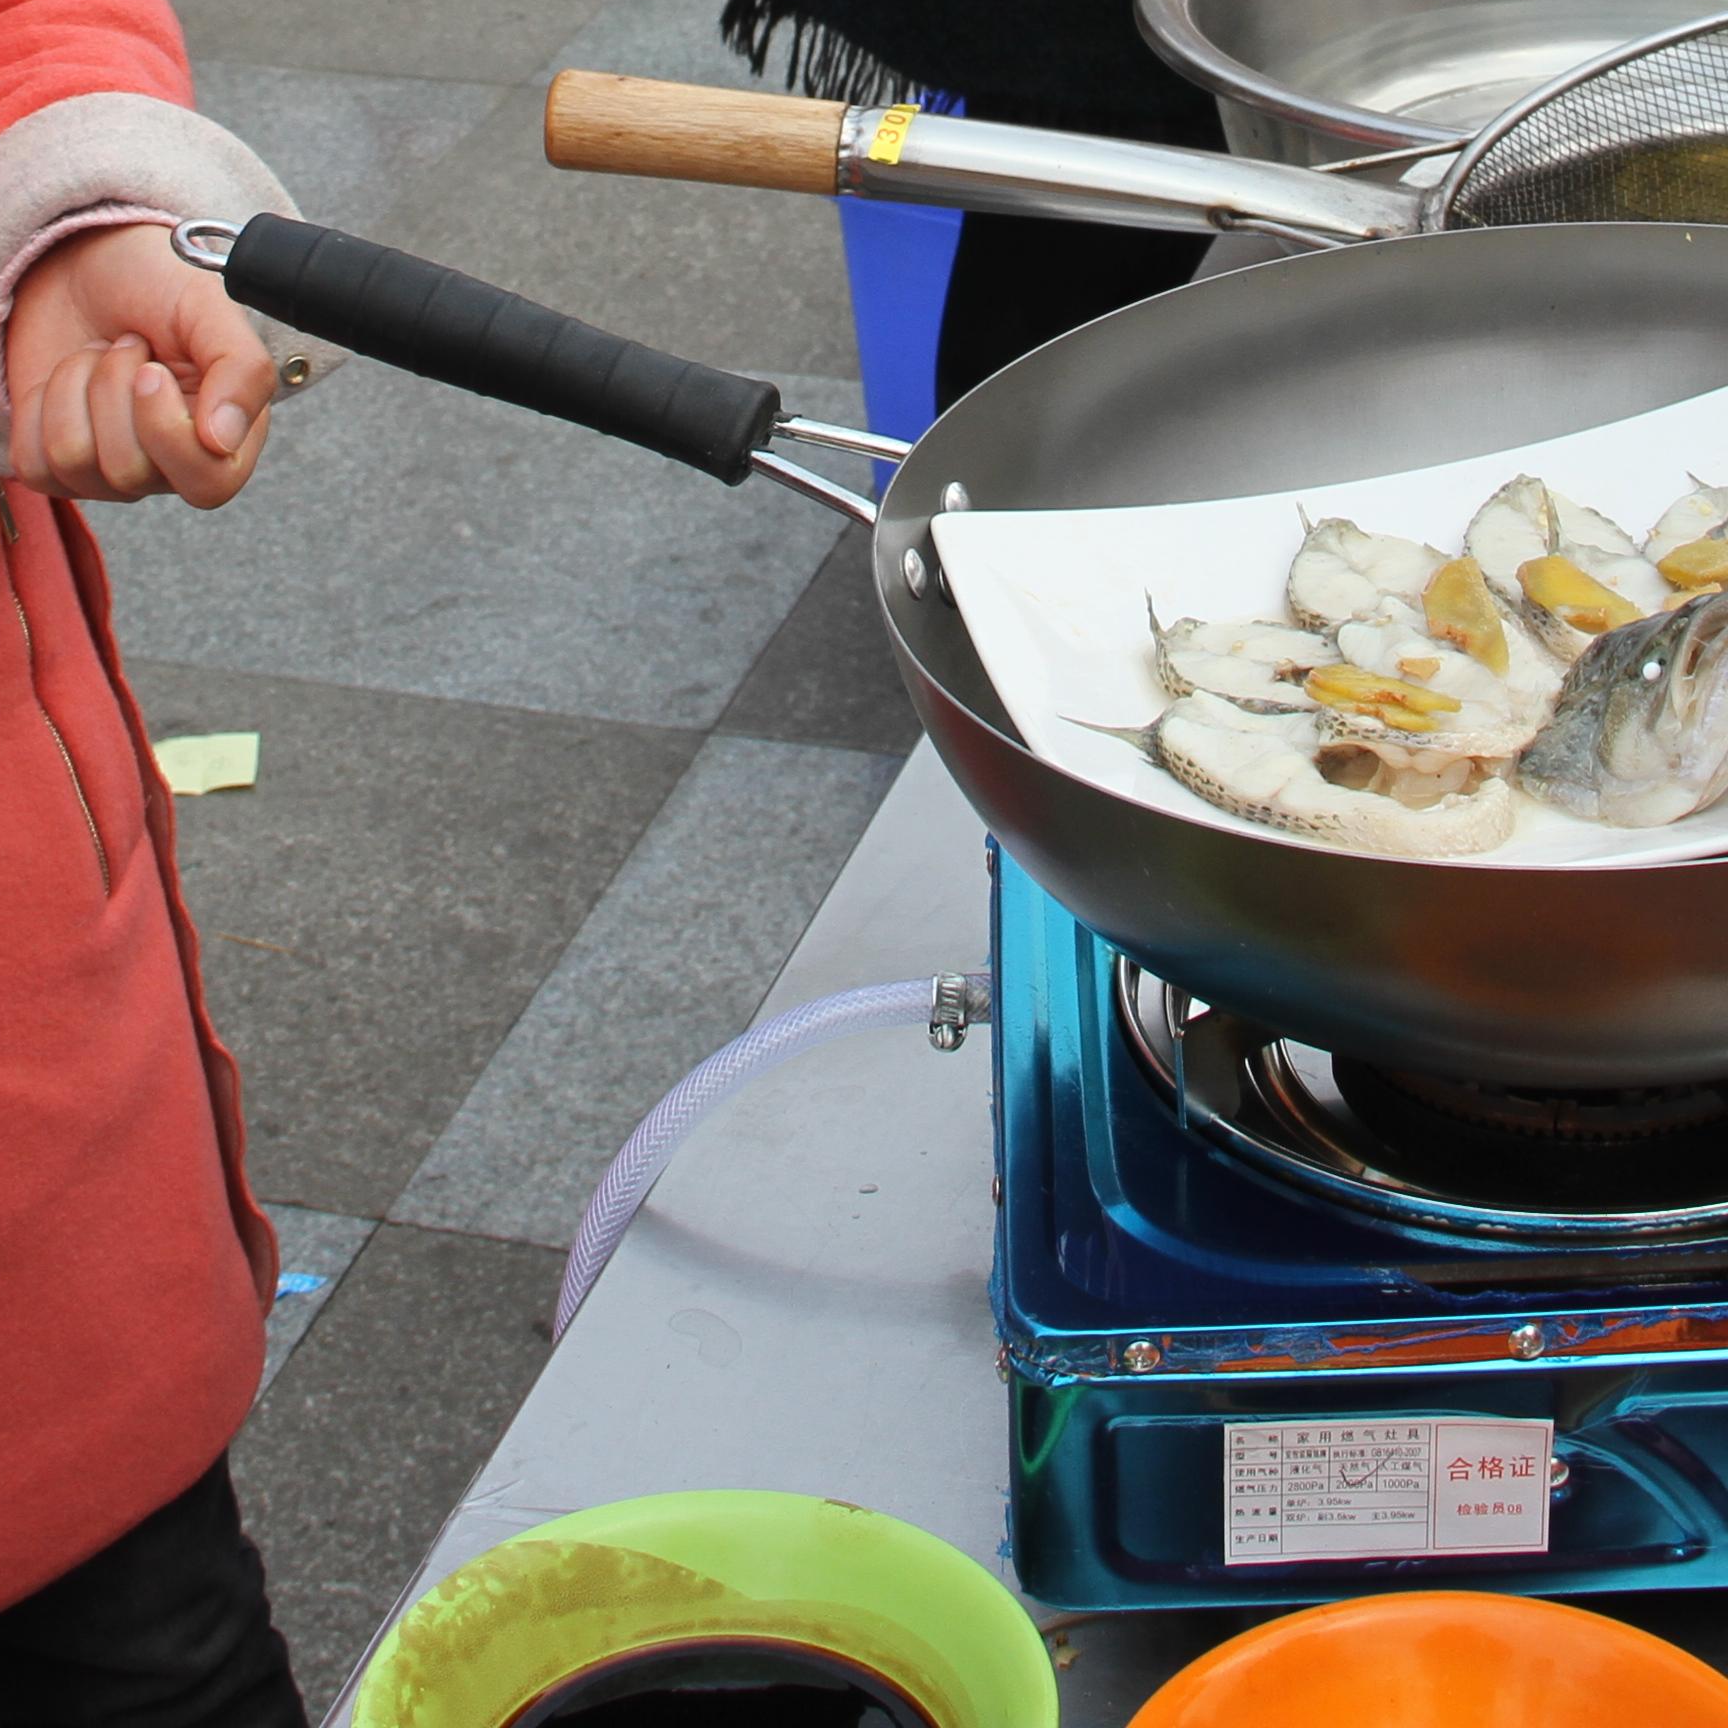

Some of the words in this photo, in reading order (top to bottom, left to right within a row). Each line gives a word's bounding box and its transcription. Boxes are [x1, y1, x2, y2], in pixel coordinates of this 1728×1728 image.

[877, 114, 906, 144] 30
[1297, 1430, 1420, 1444] 家用燃气灶具
[1447, 1455, 1536, 1480] 合格证
[1287, 1480, 1325, 1492] 2800Pa
[1382, 1478, 1420, 1490] 1000Pa
[1456, 1501, 1523, 1516] 检验员08
